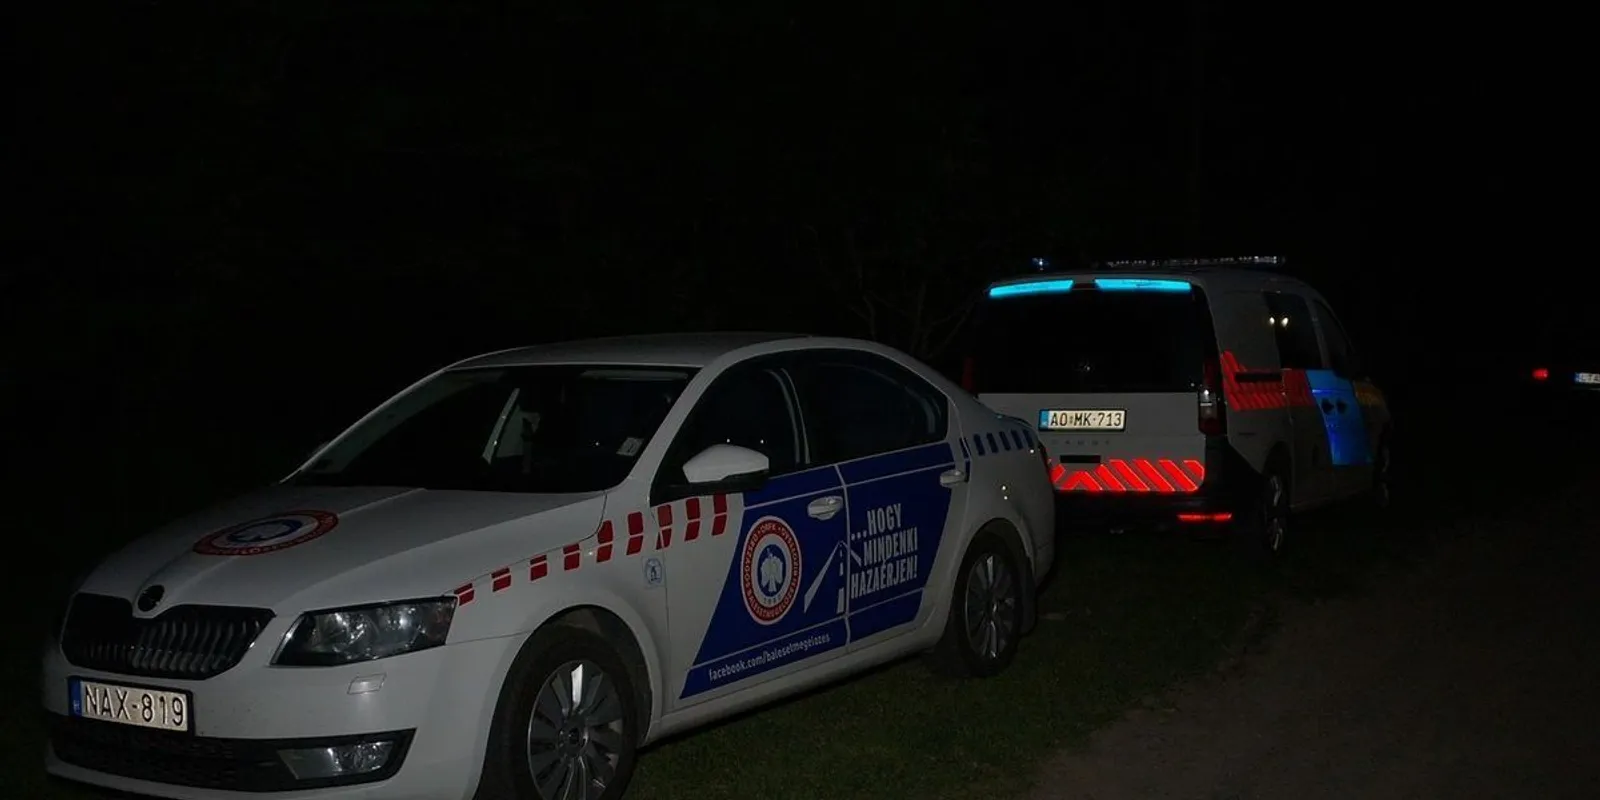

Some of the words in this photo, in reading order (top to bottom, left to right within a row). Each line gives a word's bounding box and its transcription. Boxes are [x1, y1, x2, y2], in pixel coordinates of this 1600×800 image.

[863, 526, 918, 567] MINDENKI
[850, 554, 918, 599] HAZAÉRJEN!
[708, 633, 831, 682] facebook.com/balesetmegelozes
[85, 683, 184, 726] NAX-819
